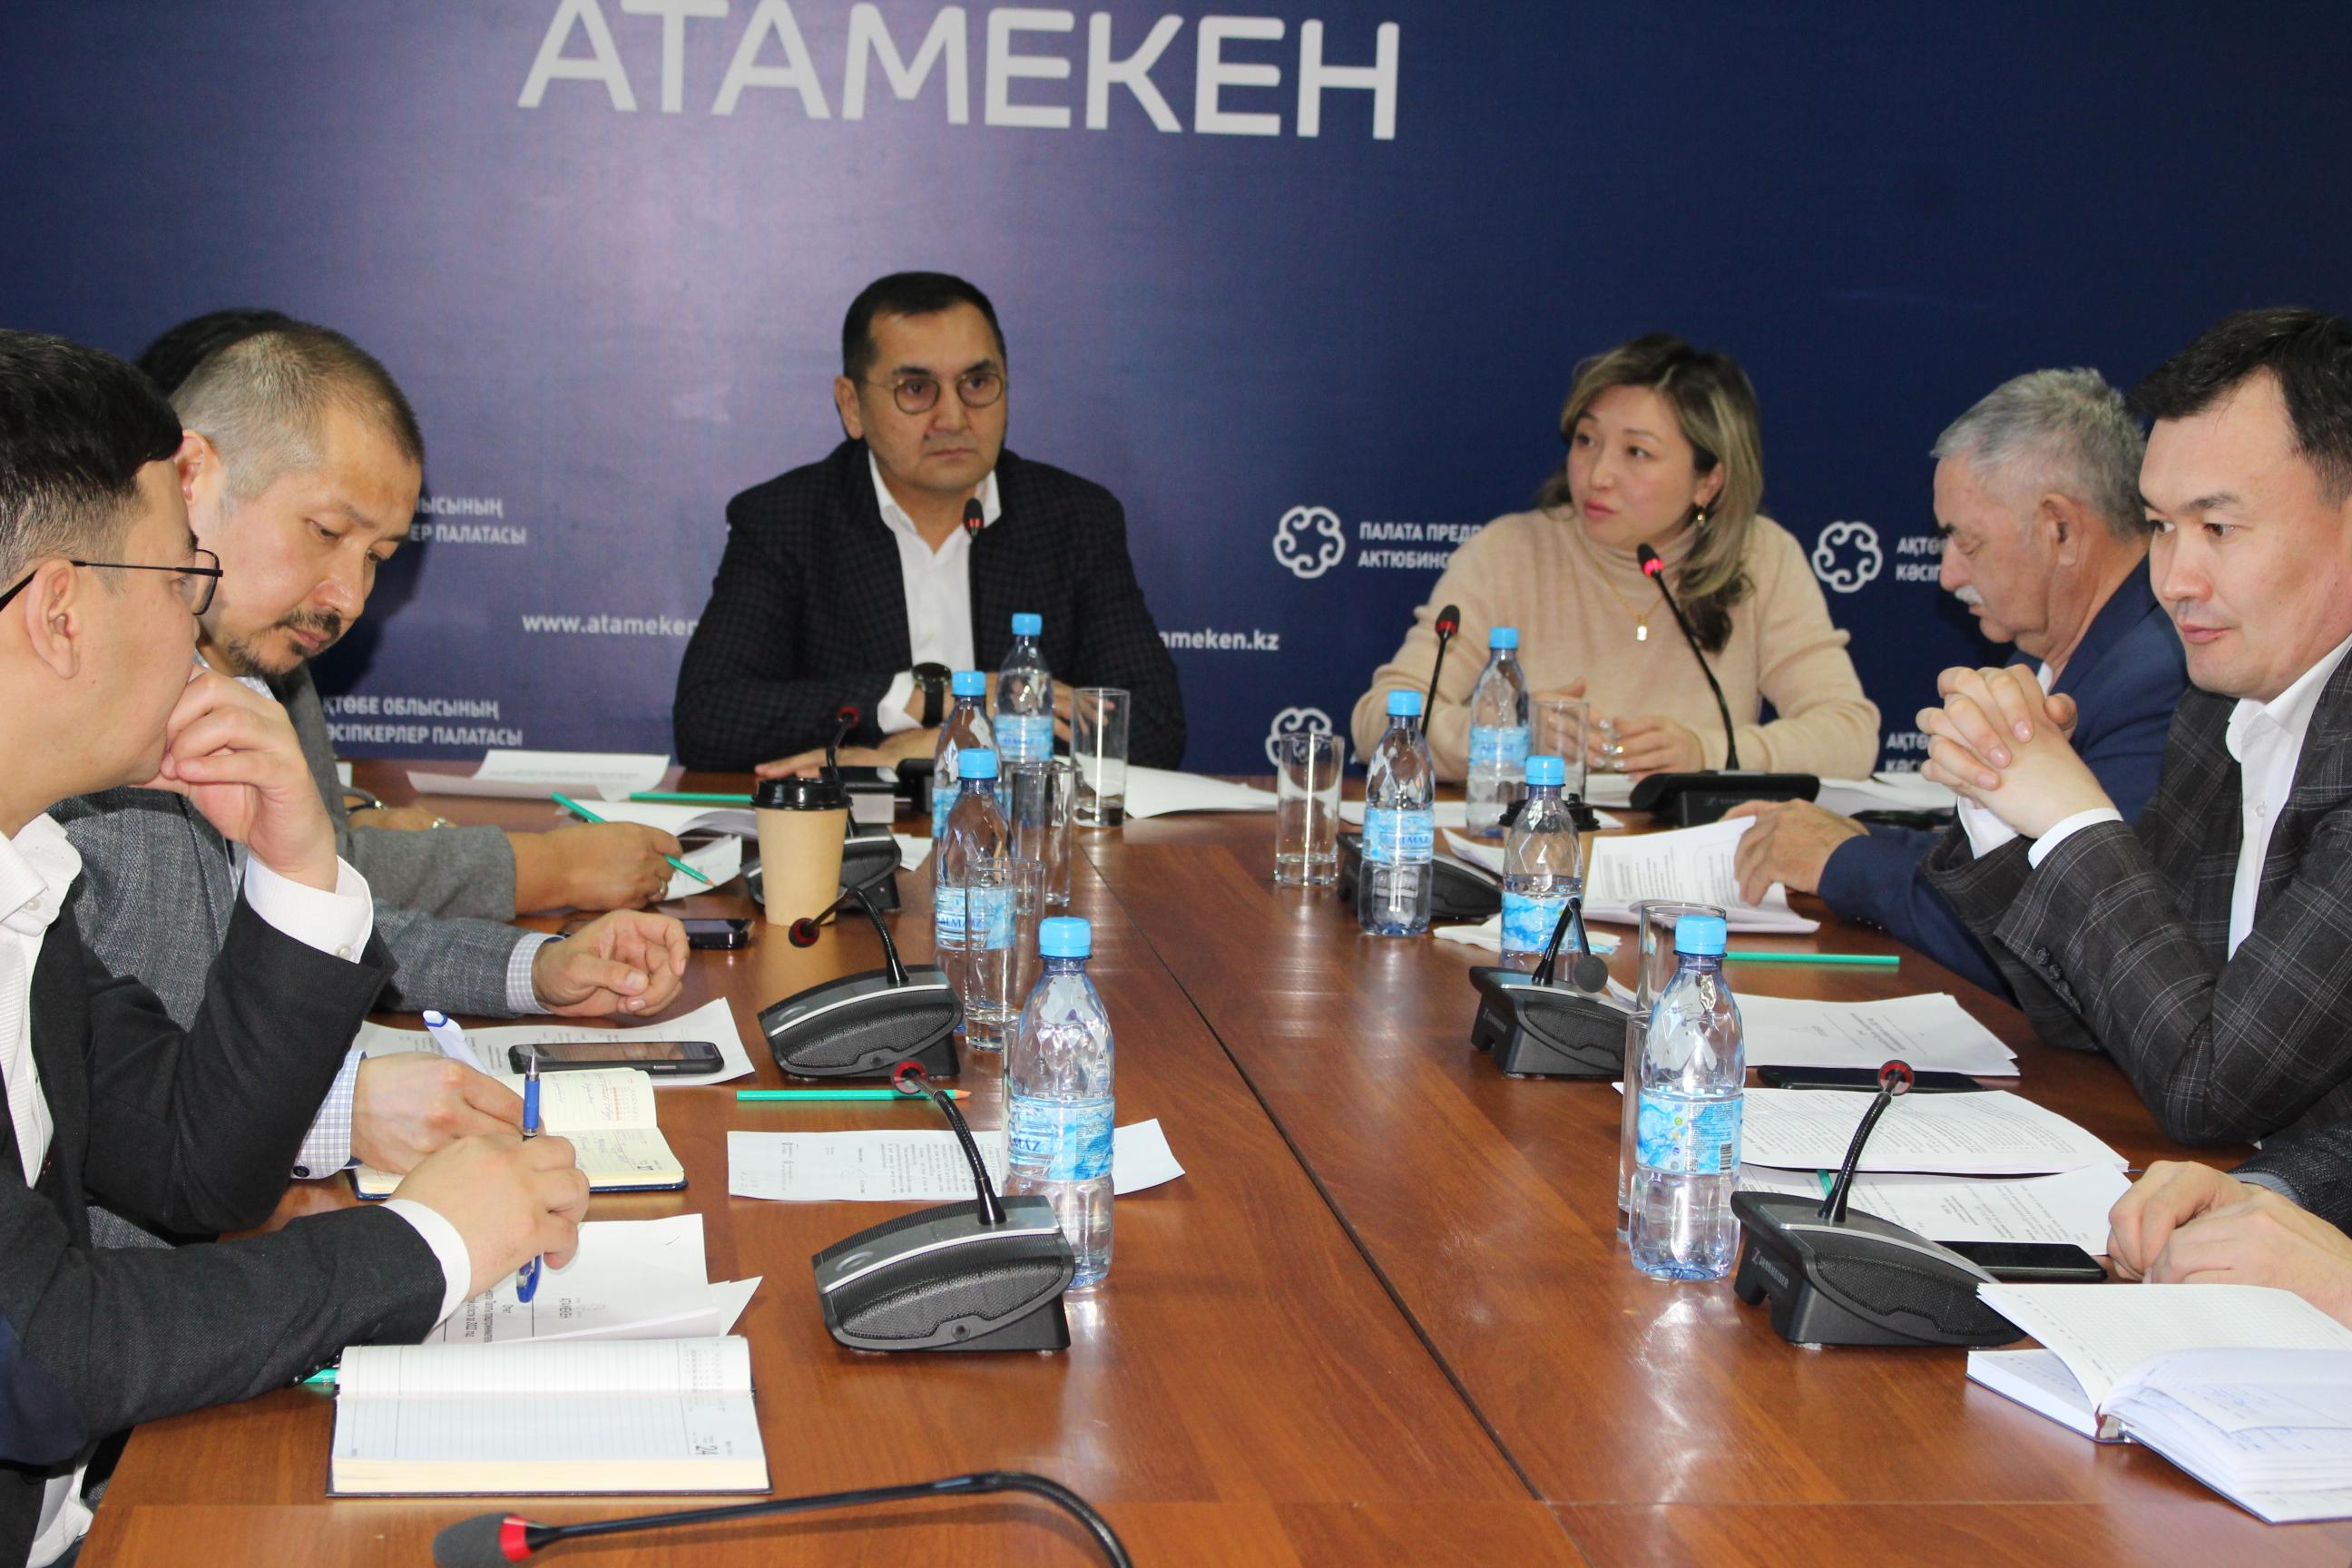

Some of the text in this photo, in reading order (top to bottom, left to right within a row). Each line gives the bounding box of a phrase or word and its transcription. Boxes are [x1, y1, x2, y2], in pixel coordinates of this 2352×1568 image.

[518, 0, 1399, 140] АТАМЕКЕН
[436, 524, 526, 544] ПАЛАТАСЫ
[1359, 522, 1423, 541] ПАЛАТА
[323, 695, 499, 720] ҚТӨБЕ ОБЛЫСЫНЫҢ
[326, 722, 523, 746] ӘСІПКЕРЛЕР ПАЛАТАСЫ
[1886, 731, 1928, 752] АҚТӨ
